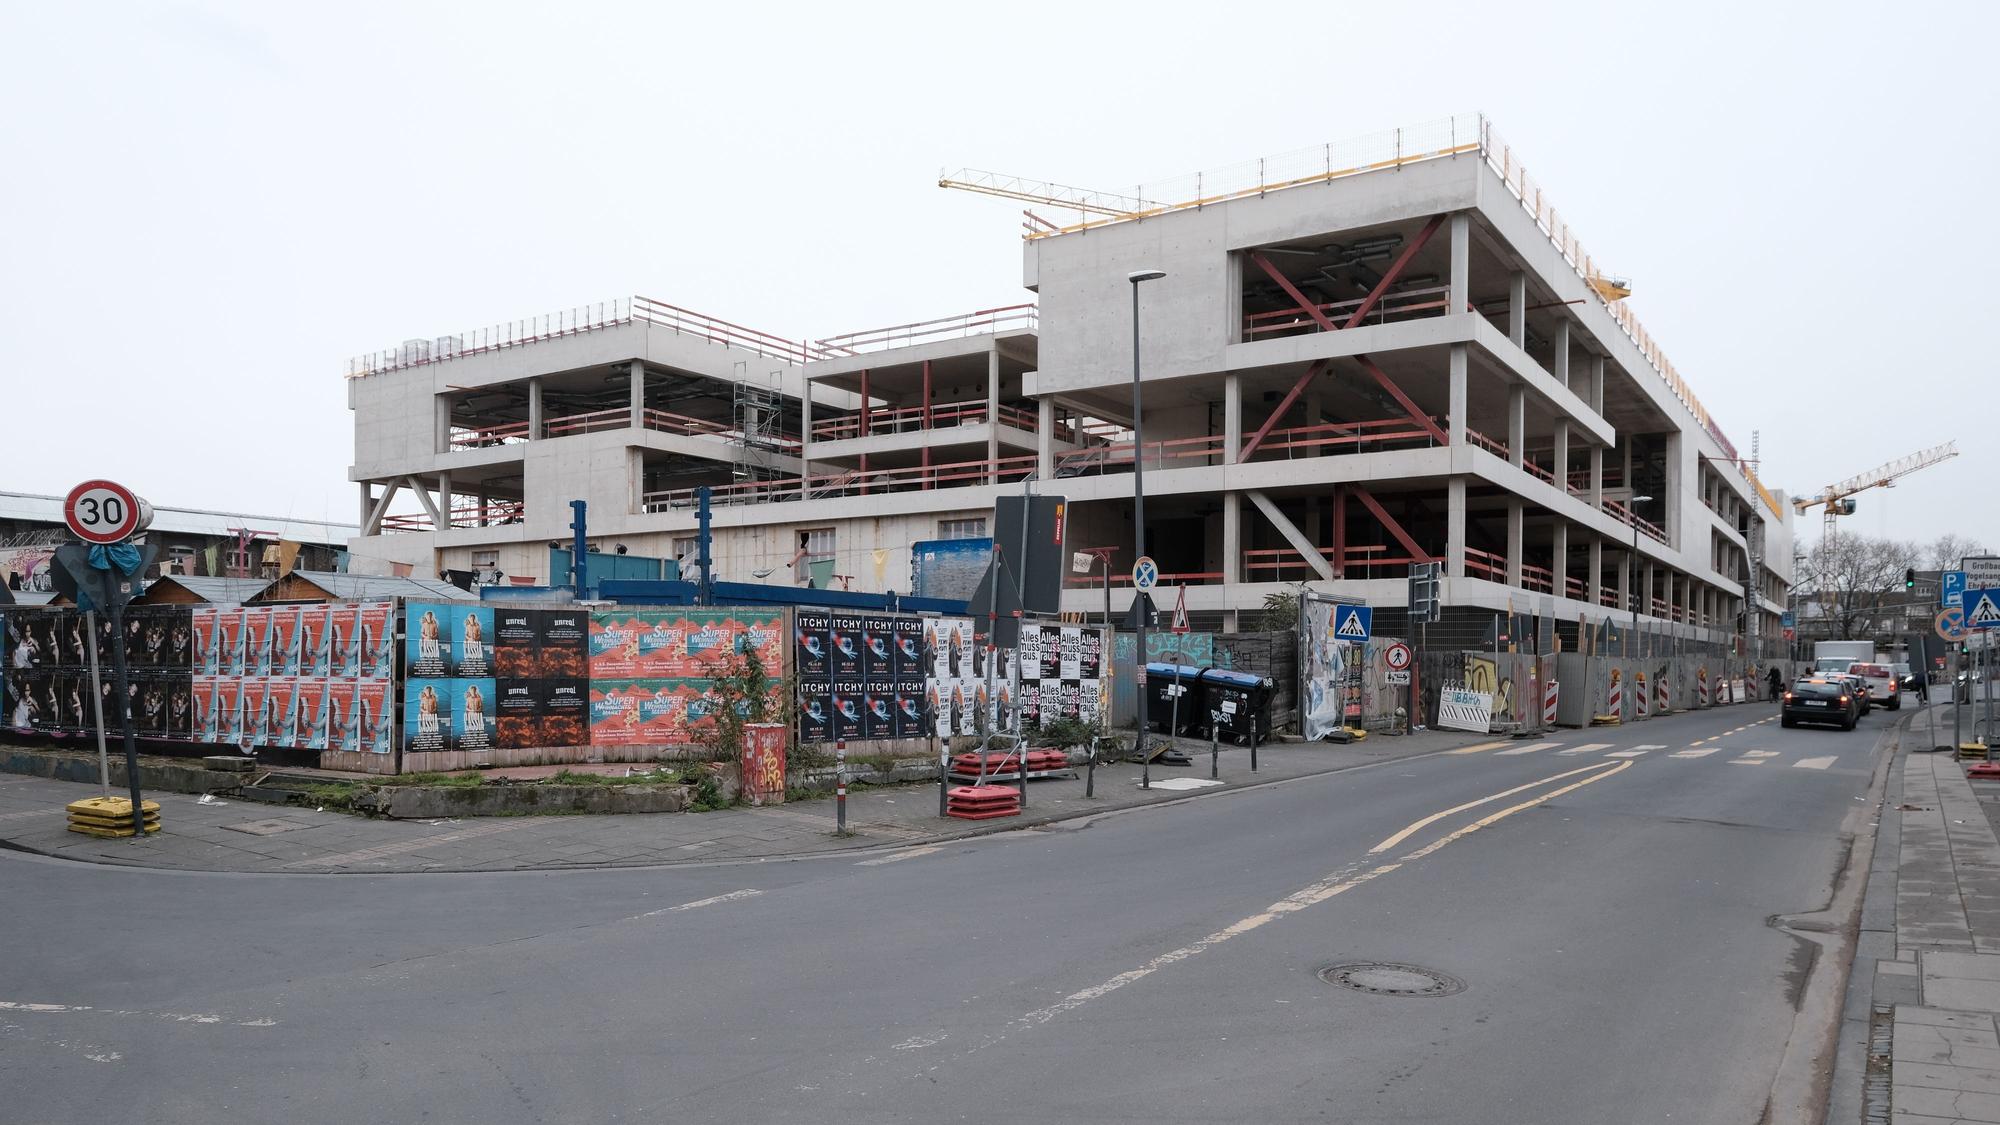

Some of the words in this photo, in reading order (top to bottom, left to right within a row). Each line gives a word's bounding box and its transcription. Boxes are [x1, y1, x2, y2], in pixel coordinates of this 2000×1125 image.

[80, 498, 122, 525] 30
[1947, 574, 1956, 588] P
[505, 617, 527, 625] unreal
[554, 618, 575, 626] unreal
[800, 618, 828, 628] ITCHY
[833, 619, 861, 628] ITCHY
[865, 621, 892, 630] ITCHY
[896, 622, 922, 630] ITCHY
[604, 626, 634, 638] SUPER
[654, 625, 683, 637] SUPER
[701, 625, 730, 637] SUPER
[748, 625, 777, 637] SUPER
[1021, 631, 1039, 643] Alles
[1041, 632, 1059, 643] Alles
[1061, 634, 1079, 644] Alles
[1081, 634, 1099, 645] Alles
[1021, 642, 1040, 651] muss
[1040, 644, 1060, 653] muss
[1061, 644, 1080, 653] muss
[1081, 645, 1099, 654] muss
[508, 686, 528, 694] unreal
[555, 686, 576, 694] unreal
[801, 683, 830, 692] ITCHY
[835, 682, 863, 692] ITCHY
[867, 683, 894, 692] ITCHY
[898, 682, 923, 691] ITCHY
[1021, 684, 1039, 696] Alles
[1041, 685, 1059, 695] Alles
[1061, 684, 1079, 695] Alles
[1081, 685, 1097, 695] Alles
[605, 693, 634, 705] SUPER
[654, 692, 683, 704] SUPER
[1021, 696, 1040, 705] muss
[1041, 696, 1060, 704] muss
[1061, 696, 1079, 704] muss
